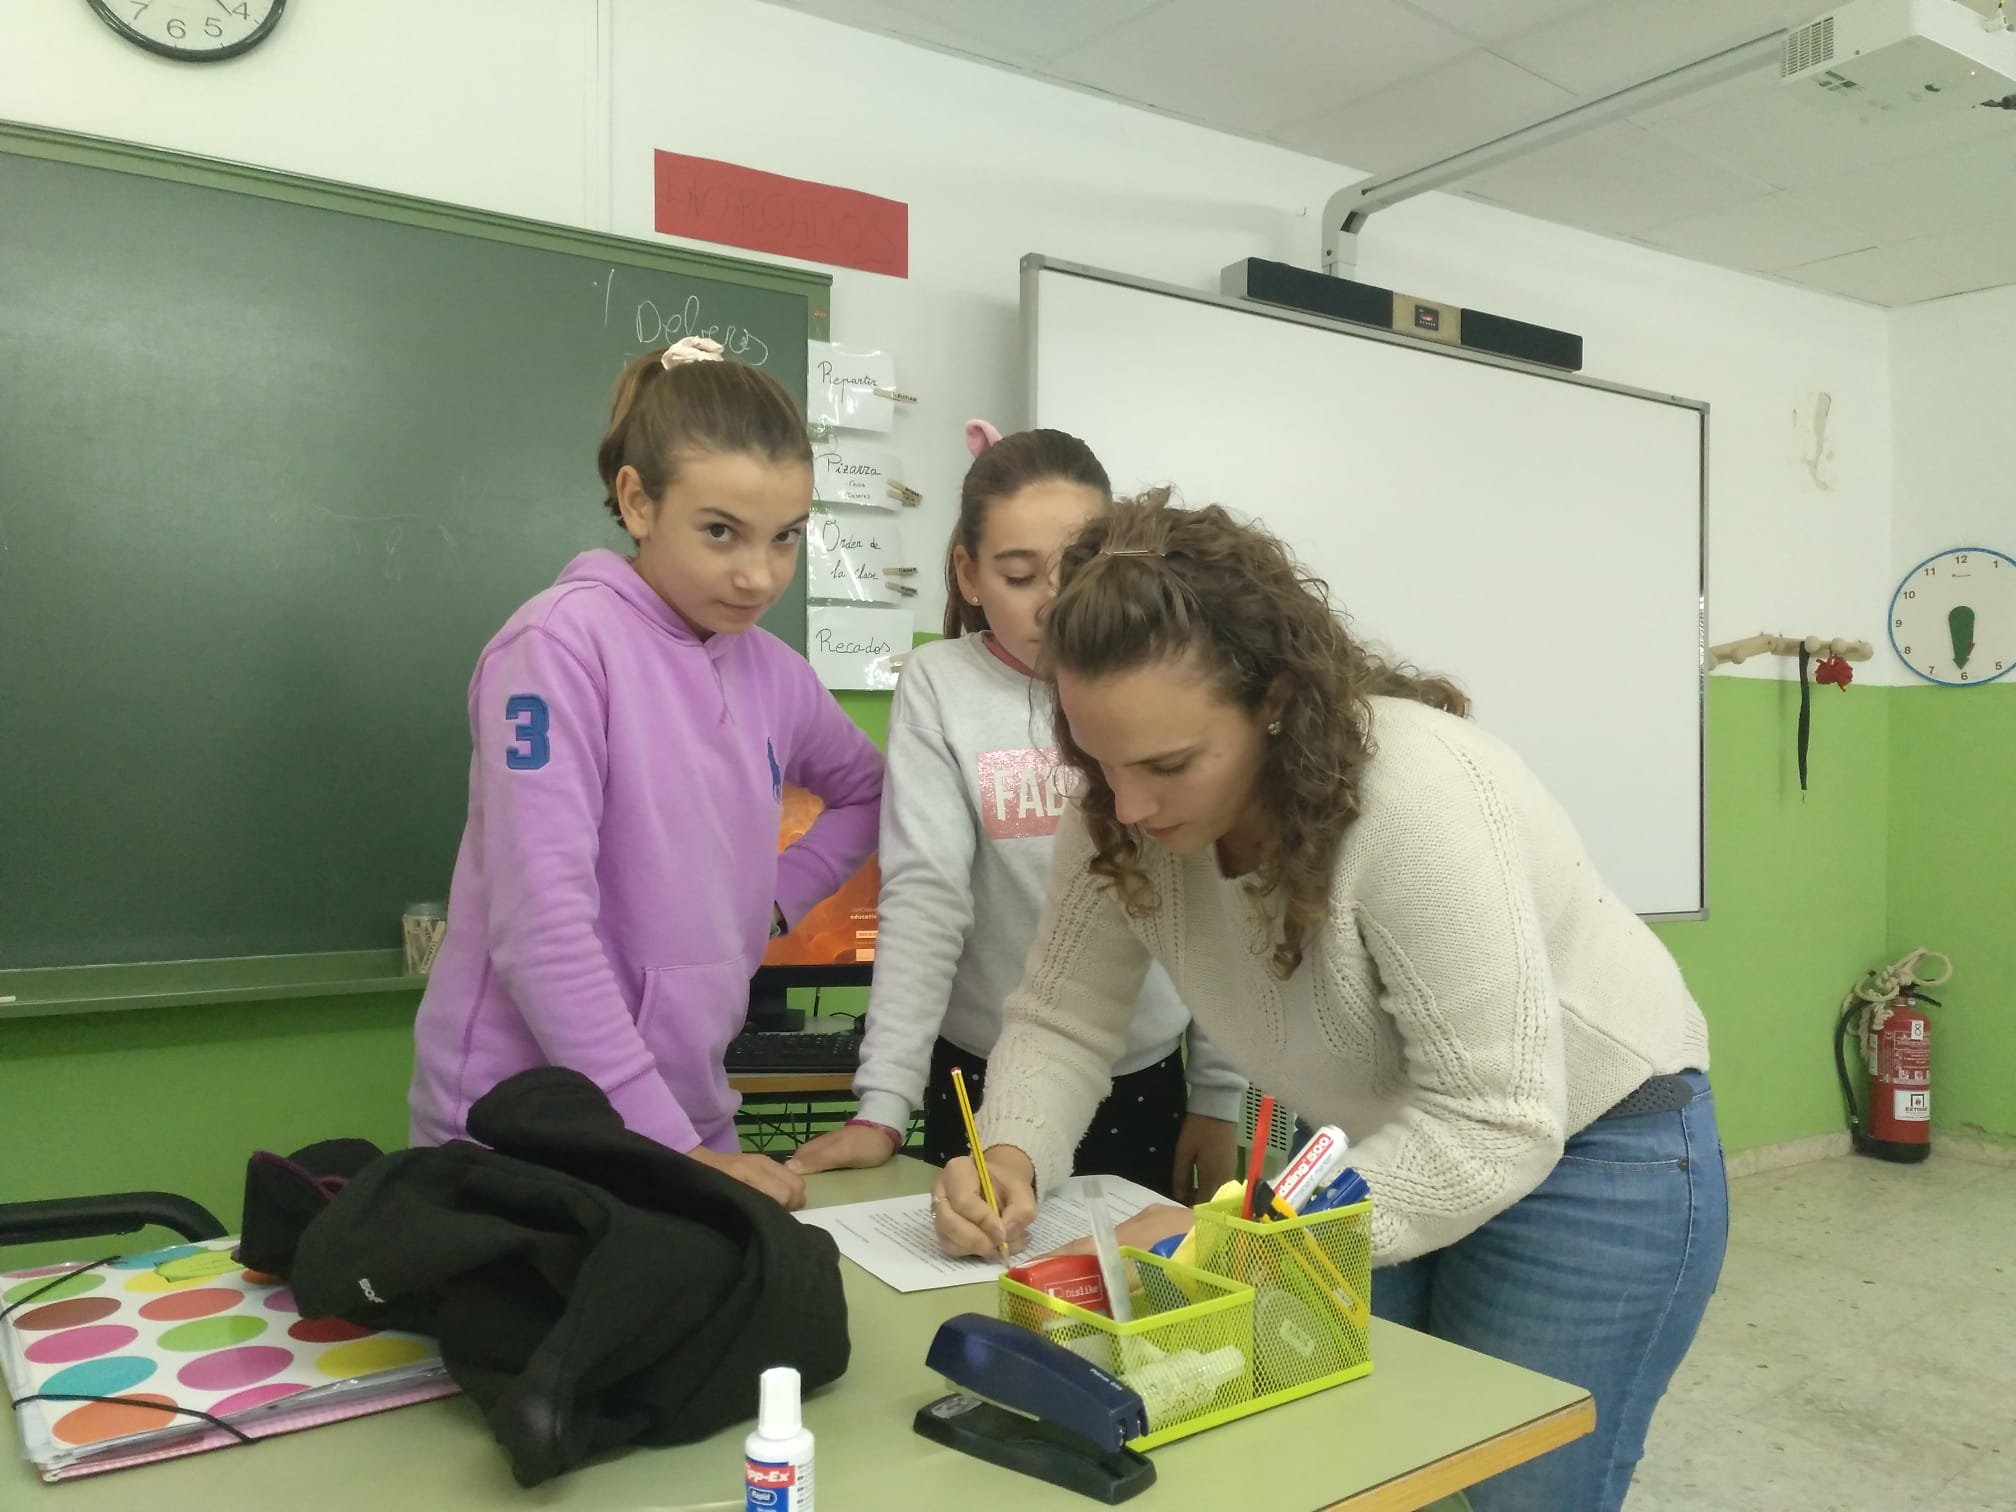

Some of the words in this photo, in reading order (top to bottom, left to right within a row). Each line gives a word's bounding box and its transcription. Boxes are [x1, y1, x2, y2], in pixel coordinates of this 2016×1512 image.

[129, 0, 150, 20] 7
[231, 2, 251, 20] 4
[166, 18, 187, 40] 6
[203, 17, 224, 38] 5
[817, 360, 879, 404] Repartir
[822, 519, 863, 552] Orden
[870, 536, 881, 550] de
[1955, 554, 1969, 565] 12
[1992, 560, 1999, 569] 1
[830, 559, 846, 579] la
[1924, 567, 1936, 577] 11
[1903, 590, 1916, 600] 10
[1895, 619, 1903, 628] 9
[815, 628, 891, 655] Recados
[1904, 646, 1912, 655] 8
[1928, 665, 1935, 675] 7
[1995, 661, 2003, 671] 5
[1960, 671, 1969, 681] 6
[505, 692, 550, 771] 3
[1913, 1022, 1922, 1037] 8
[1278, 1161, 1310, 1197] dding
[1305, 1136, 1331, 1162] 500
[1064, 1284, 1099, 1298] Dislike
